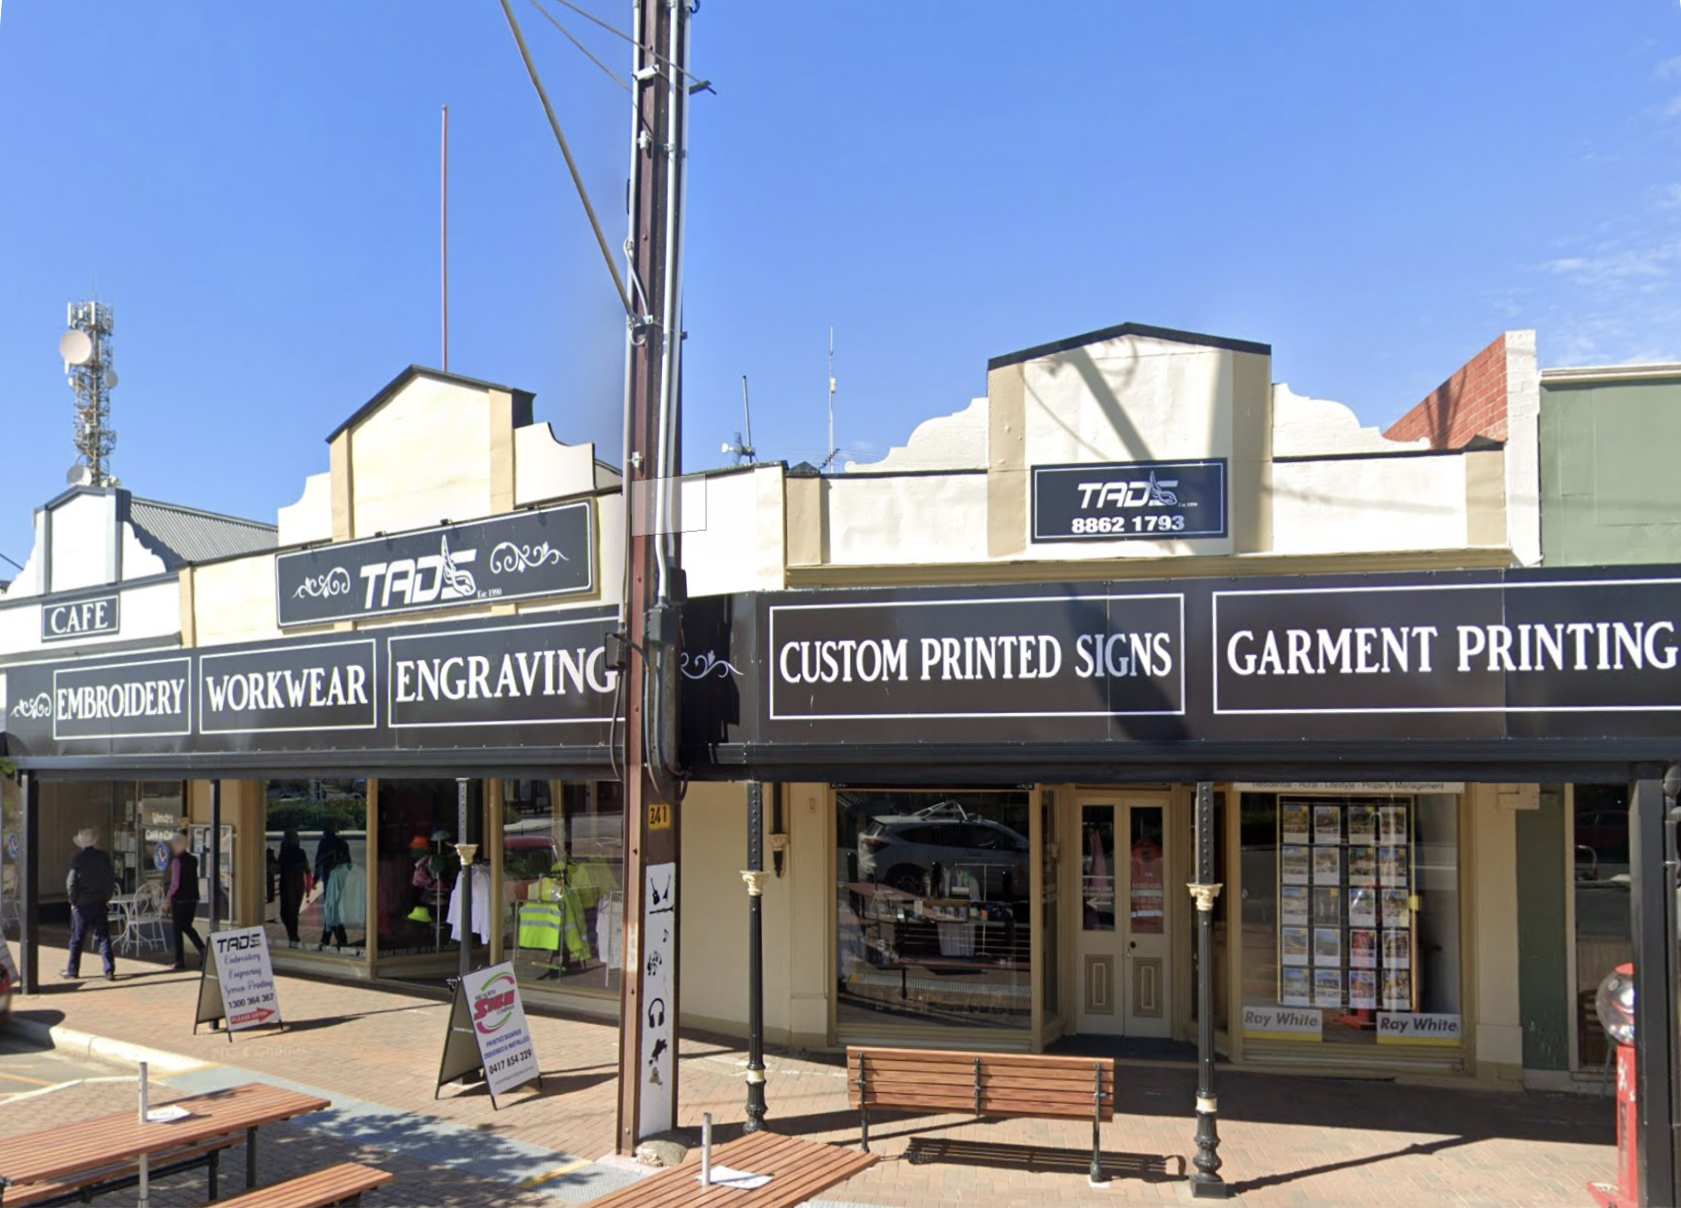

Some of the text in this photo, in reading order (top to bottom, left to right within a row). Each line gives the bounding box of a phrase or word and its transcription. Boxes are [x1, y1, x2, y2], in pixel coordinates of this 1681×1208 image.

[1077, 480, 1178, 509] TADS
[1071, 515, 1185, 534] 8862 1793
[360, 548, 477, 609] TADS
[51, 601, 108, 634] CAFE
[779, 632, 1172, 683] CUSTOM PRINTED SIGNS
[1226, 621, 1678, 676] GARMENT PRINTING
[396, 646, 618, 702] ENGRAVING
[57, 679, 185, 720] EMBROIDERY
[206, 665, 368, 712] WORKWEAR
[650, 805, 667, 824] 241
[217, 933, 262, 953] TADS
[229, 968, 263, 980] Engraving
[247, 980, 274, 991] Printing
[228, 1000, 246, 1010] 1300
[474, 989, 515, 1021] SIGN
[1245, 1011, 1319, 1027] Ray White
[1380, 1017, 1458, 1033] Ray White
[488, 1049, 532, 1074] 0417 854 329
